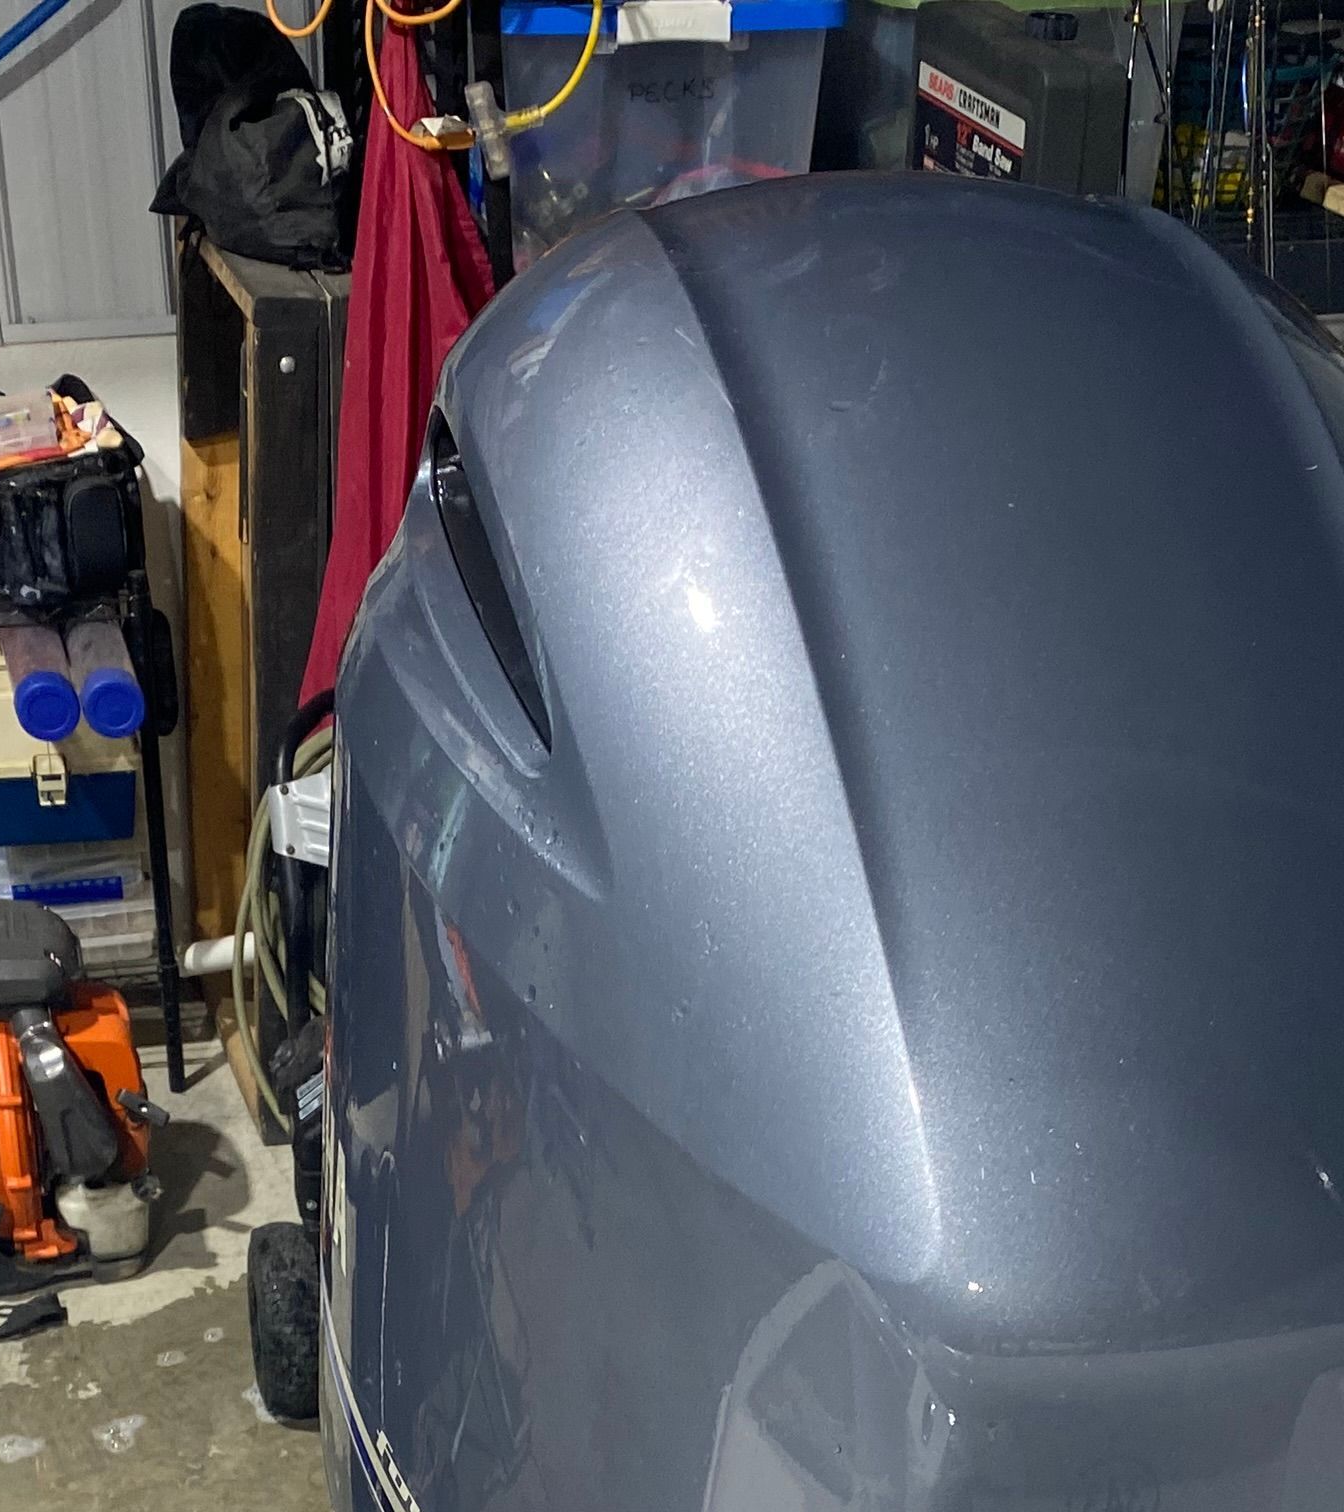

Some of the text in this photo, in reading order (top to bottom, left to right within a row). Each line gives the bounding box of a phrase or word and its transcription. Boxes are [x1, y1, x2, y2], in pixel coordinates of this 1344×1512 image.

[928, 71, 1001, 129] SEARS CRAFTSMAN
[972, 133, 994, 162] Band
[994, 147, 1013, 174] Saw
